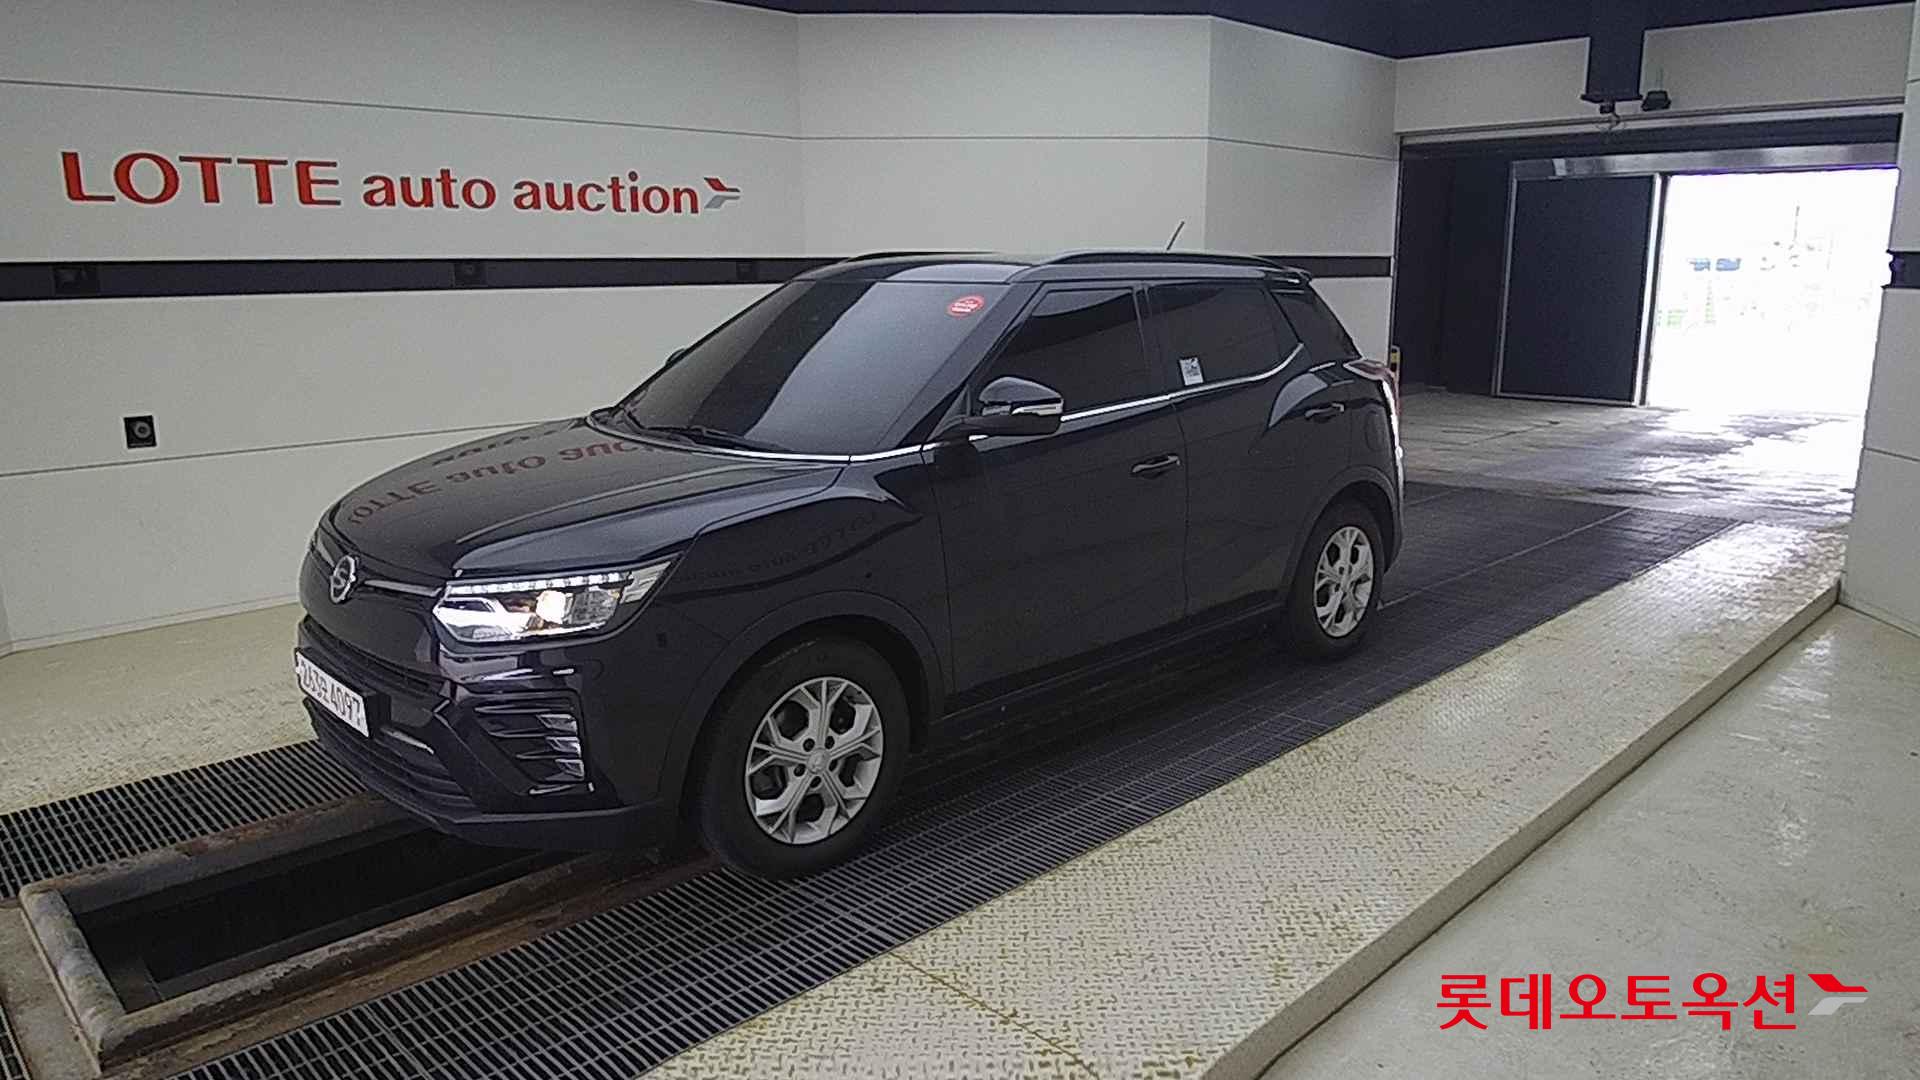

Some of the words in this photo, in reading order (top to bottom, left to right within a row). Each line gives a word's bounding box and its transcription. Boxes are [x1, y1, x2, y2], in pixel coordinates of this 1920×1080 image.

[61, 152, 341, 206] LOTTE
[362, 168, 496, 209] auto
[513, 171, 700, 214] auction
